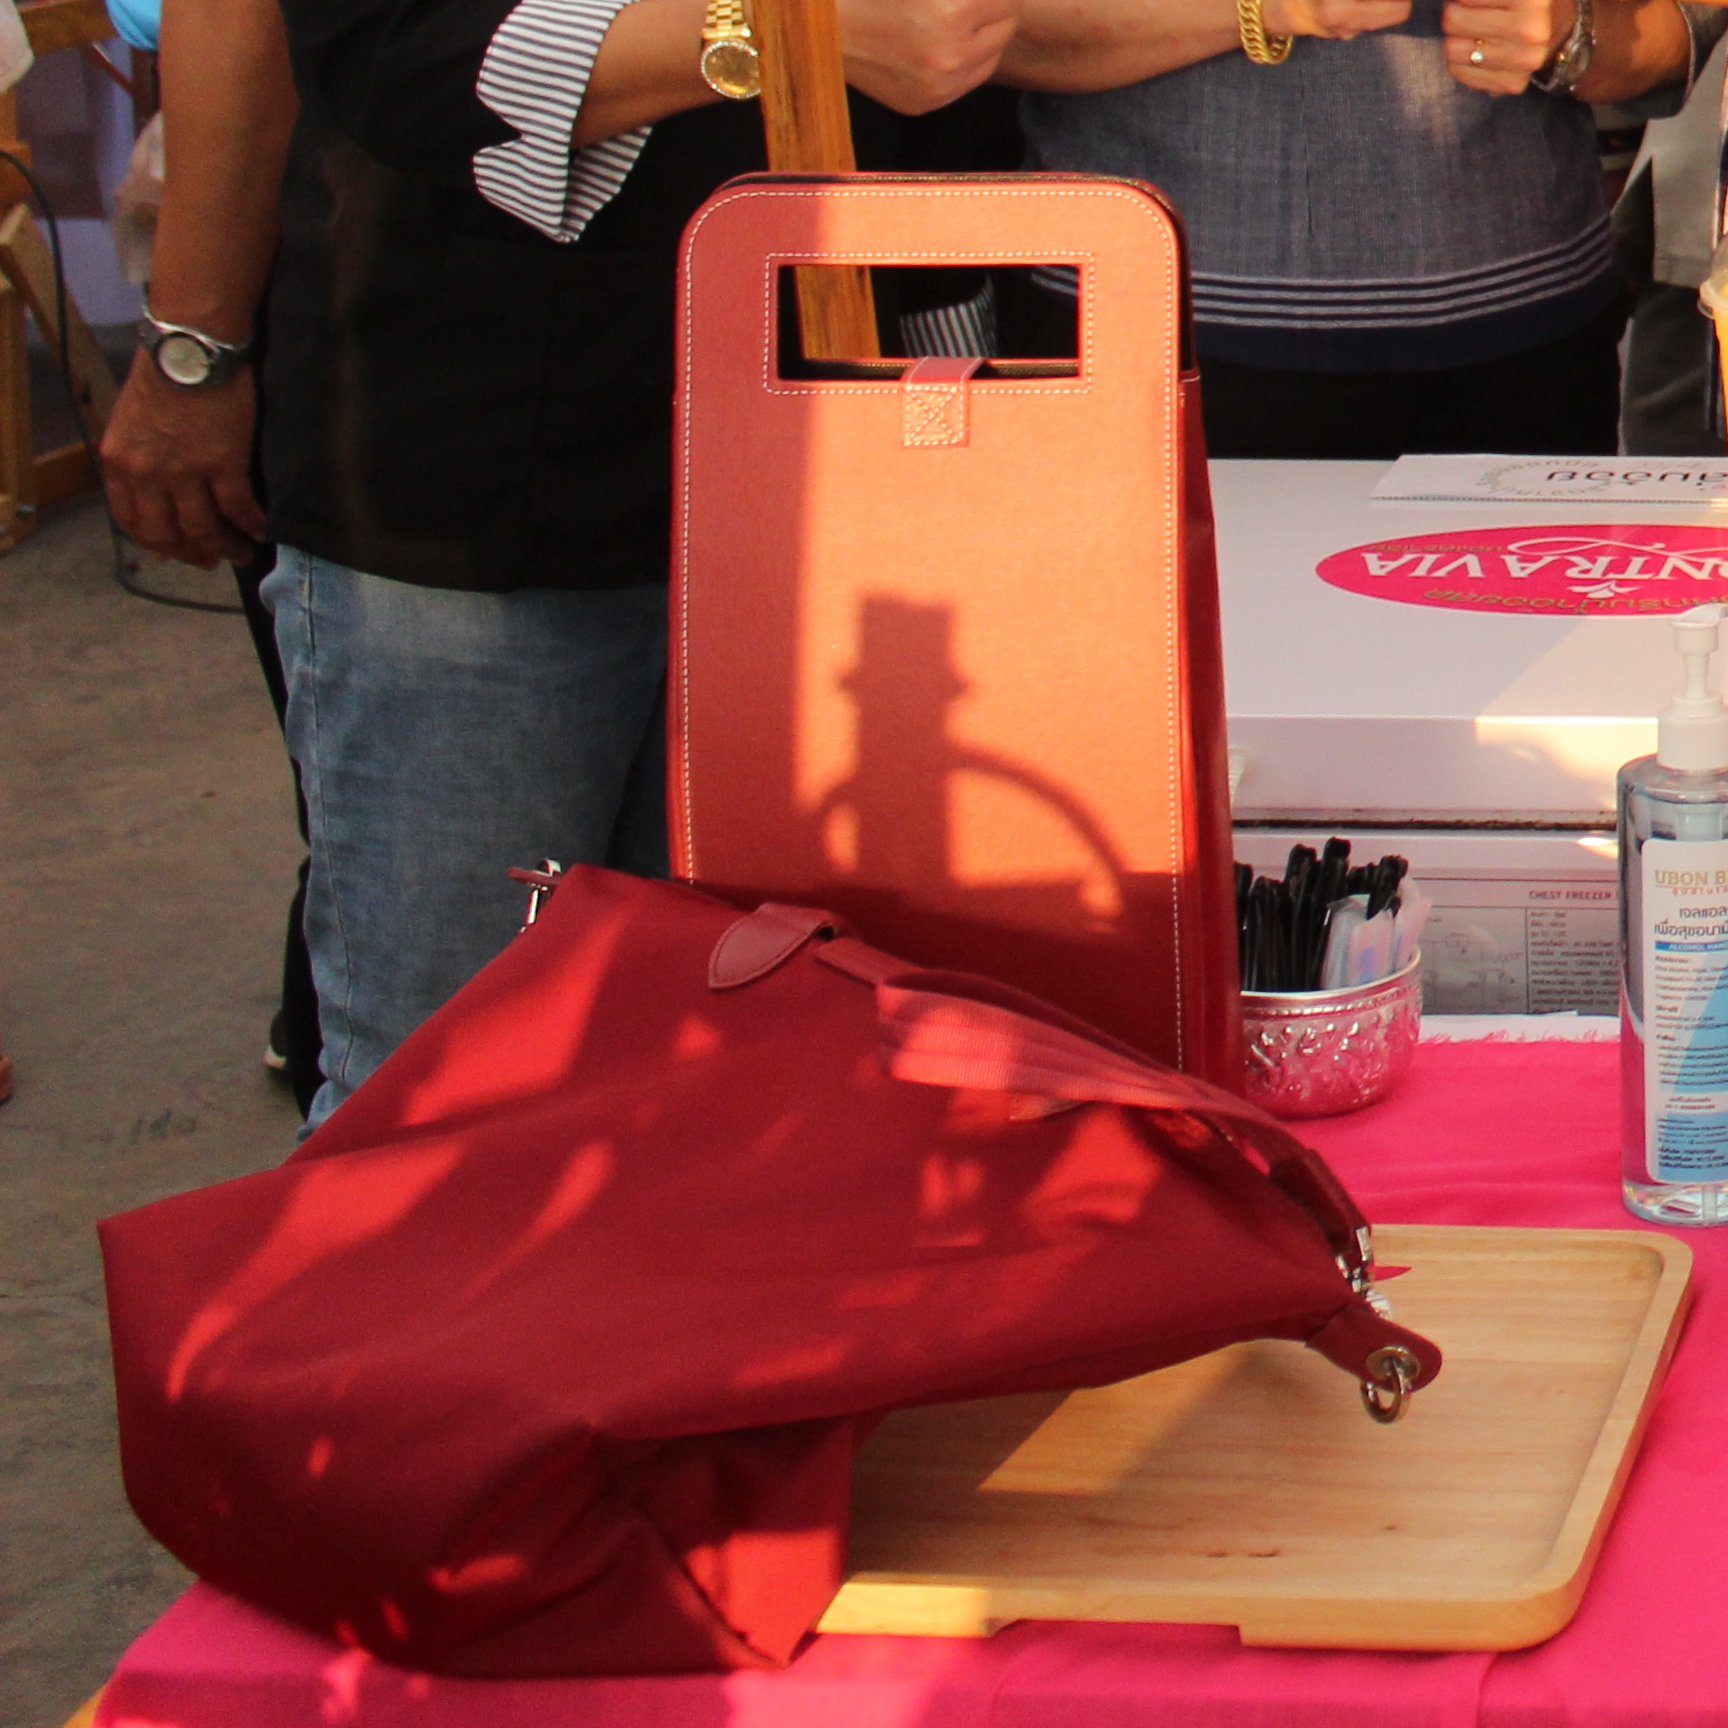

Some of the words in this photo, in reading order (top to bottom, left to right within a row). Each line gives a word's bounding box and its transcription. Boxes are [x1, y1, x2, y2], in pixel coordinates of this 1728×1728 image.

[1655, 869, 1708, 887] UBON
[1529, 890, 1562, 900] CHEST
[1565, 891, 1612, 901] FREEZER
